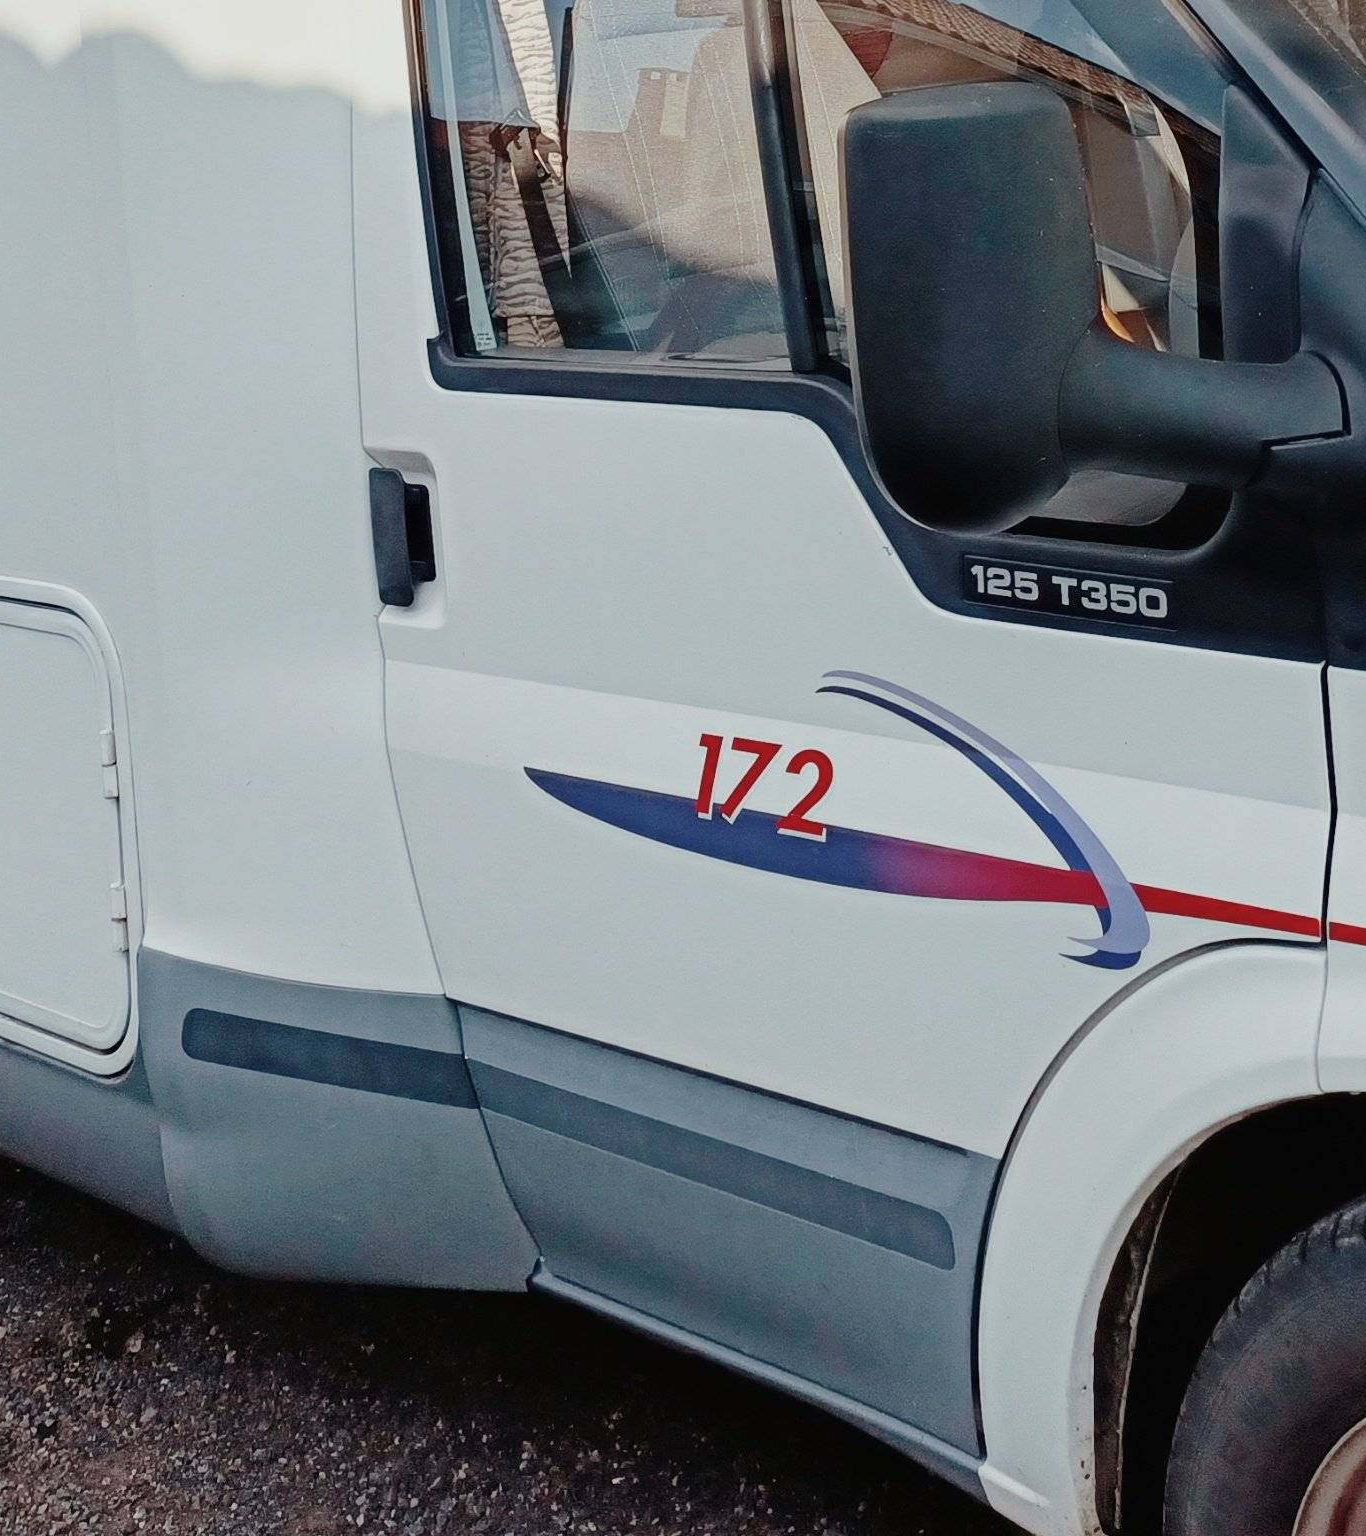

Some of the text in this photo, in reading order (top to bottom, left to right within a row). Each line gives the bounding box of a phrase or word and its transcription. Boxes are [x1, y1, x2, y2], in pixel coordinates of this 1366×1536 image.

[970, 564, 1169, 619] 125 T350
[695, 732, 835, 841] 172
